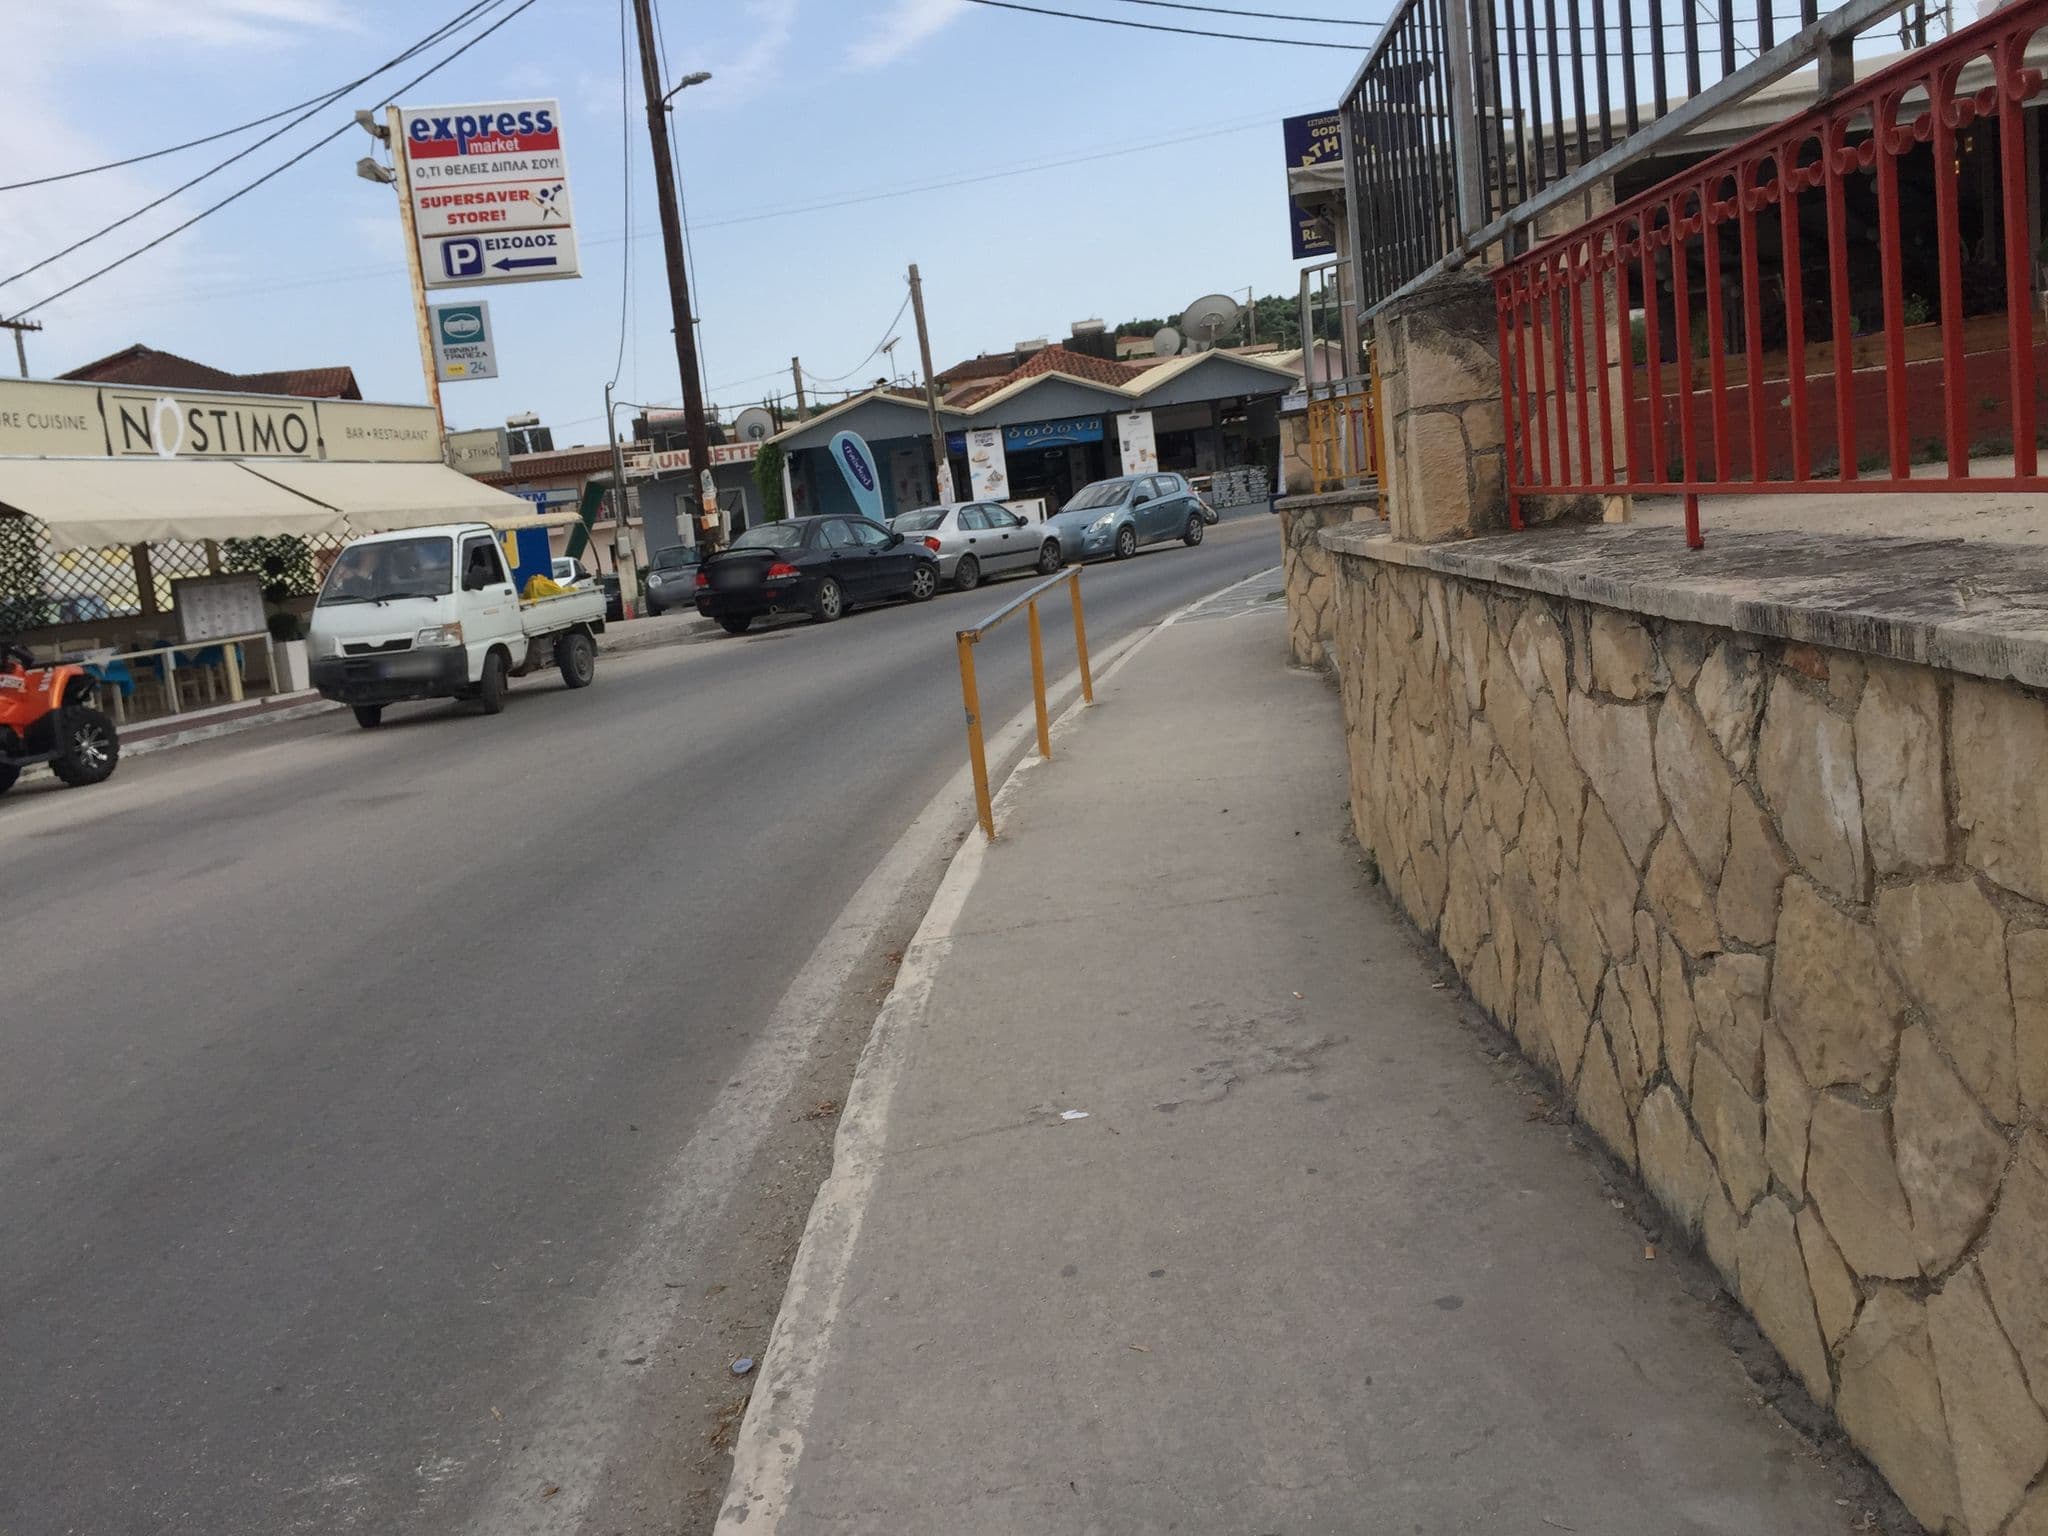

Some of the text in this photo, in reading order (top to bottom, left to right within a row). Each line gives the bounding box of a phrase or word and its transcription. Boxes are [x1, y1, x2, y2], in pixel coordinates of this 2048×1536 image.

[410, 110, 553, 155] express
[469, 138, 519, 154] market
[1302, 136, 1339, 166] ATH
[416, 158, 559, 179] Ο,ΤΙ ΘΕΛΕΙΣ ΔΙΠΛΑ ΣΟΥ!
[420, 189, 530, 209] SUPERSAVER
[447, 210, 506, 225] STORE!
[485, 234, 557, 251] ΕΙΣΟΔΟΣ
[448, 243, 478, 275] P
[470, 361, 487, 374] 24
[0, 412, 88, 431] RE CUISINE
[119, 397, 309, 459] NOSTIMO
[346, 427, 429, 441] BAR RESTAURANT
[634, 444, 760, 470] LAUNETTE
